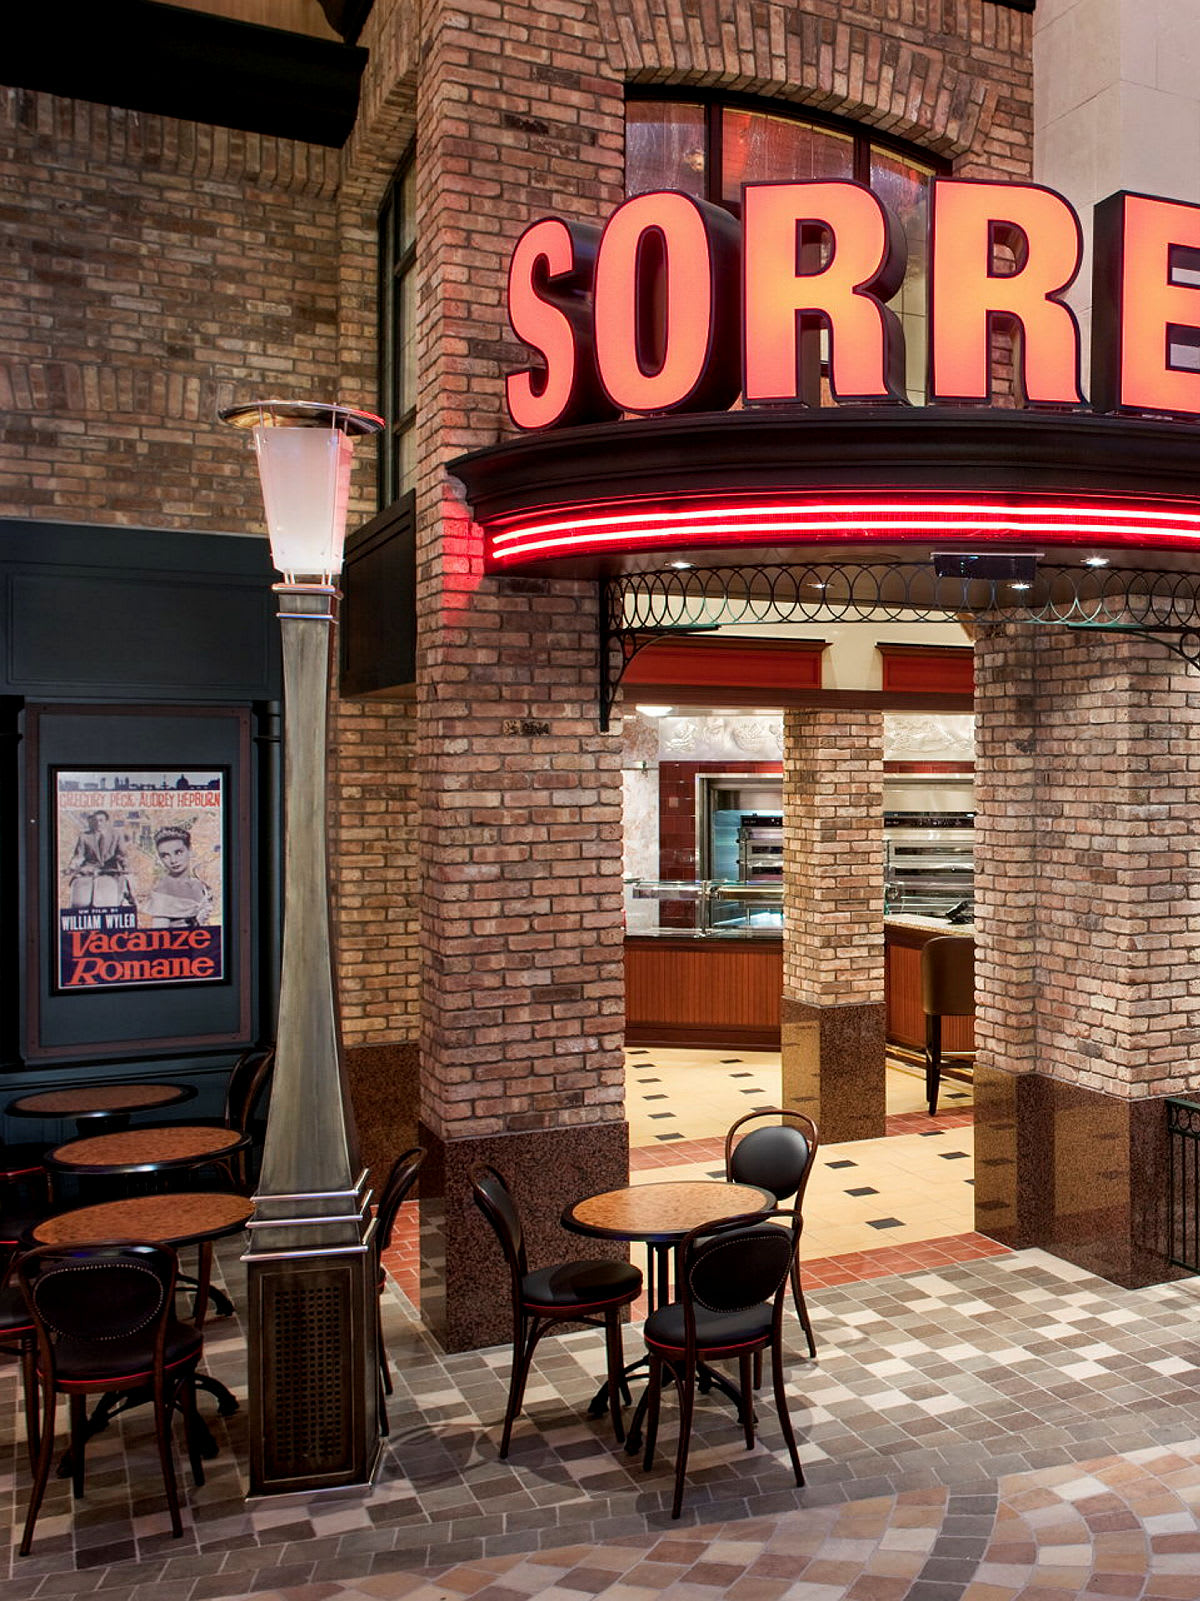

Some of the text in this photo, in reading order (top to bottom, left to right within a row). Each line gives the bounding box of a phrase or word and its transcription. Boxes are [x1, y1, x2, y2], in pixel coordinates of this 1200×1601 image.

[139, 792, 175, 808] AUDREY
[177, 792, 221, 807] HEPBURN
[61, 913, 136, 931] WILLIAM WYLER
[68, 928, 211, 957] Vacanze
[64, 956, 215, 985] Romane
